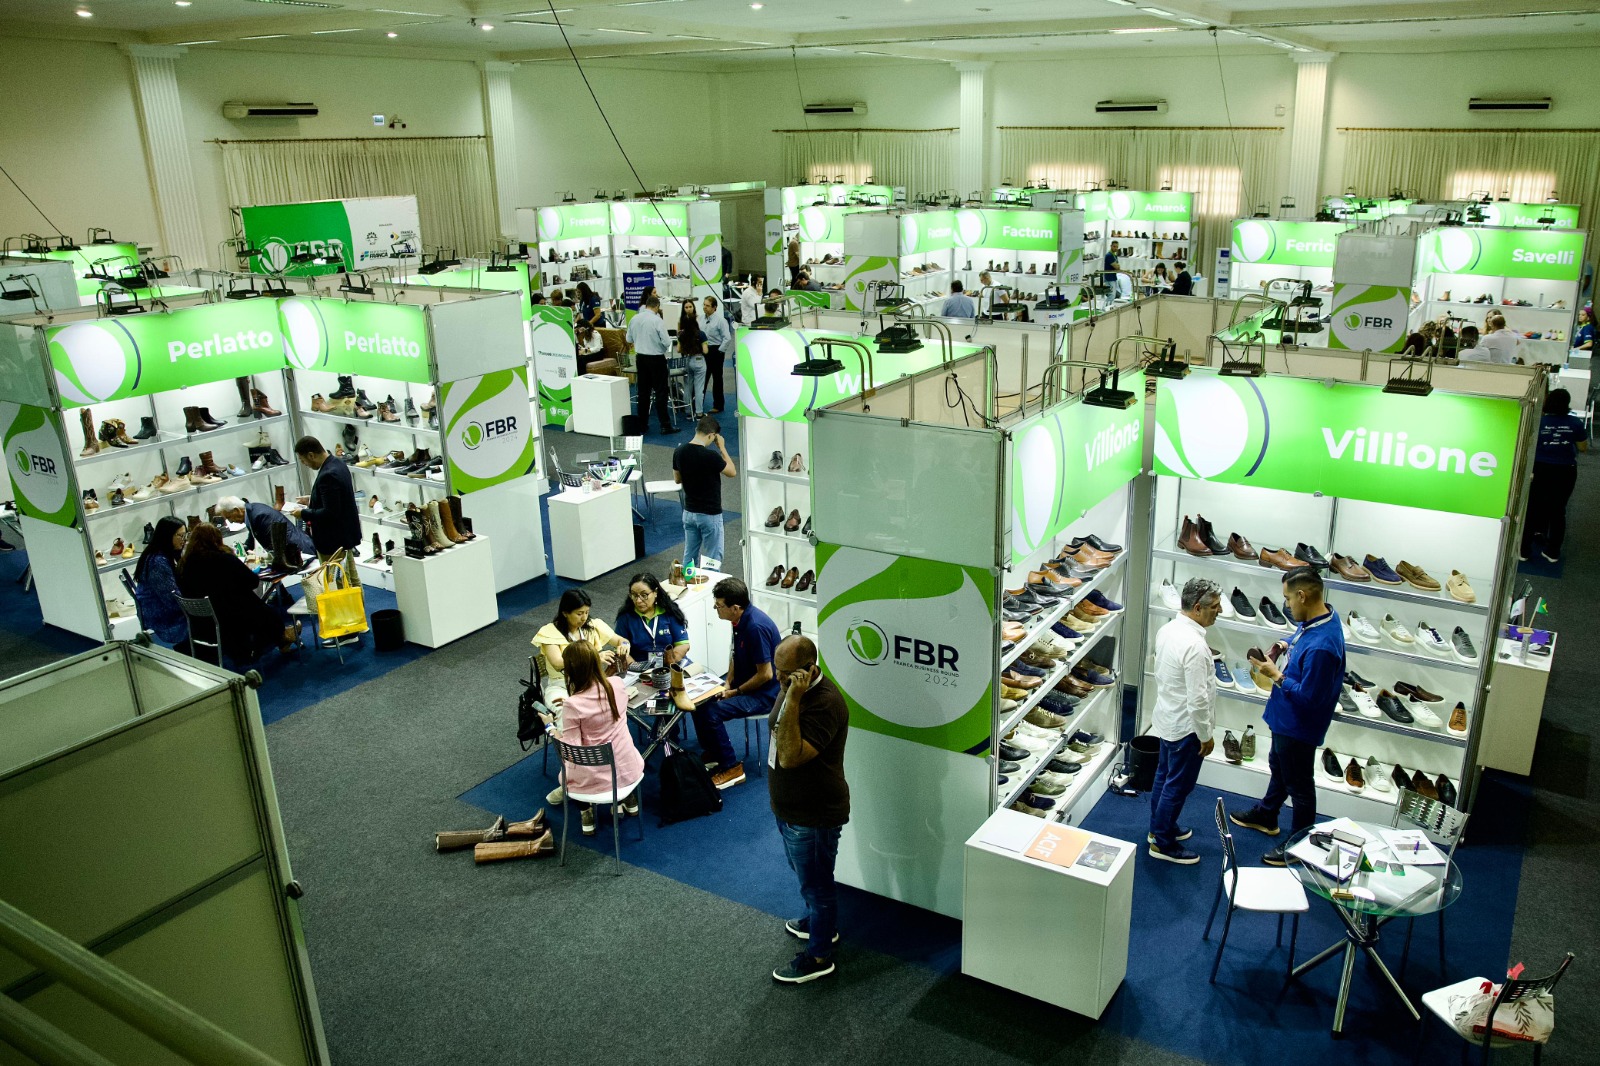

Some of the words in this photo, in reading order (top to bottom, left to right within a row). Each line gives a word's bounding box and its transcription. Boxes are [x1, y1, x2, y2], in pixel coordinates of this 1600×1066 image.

[1145, 203, 1187, 213] Amarok
[570, 217, 606, 228] Freeway
[641, 215, 683, 228] Freeway
[1513, 215, 1573, 227] Macot
[1002, 225, 1053, 239] Factum
[705, 255, 716, 263] FBR
[1511, 248, 1575, 265] Savelli
[1364, 316, 1393, 329] FBR
[167, 329, 274, 363] Perlatto
[344, 330, 421, 358] Perlatto
[833, 372, 884, 395] Wi
[485, 415, 518, 438] FBR
[1084, 418, 1140, 472] Villione
[1321, 426, 1498, 477] Villione
[30, 454, 57, 475] FBR
[894, 634, 959, 672] FBR
[893, 659, 914, 669] FRANCA
[914, 664, 940, 674] BUSINESS
[924, 672, 958, 688] 2024
[1033, 831, 1062, 858] ACIF
